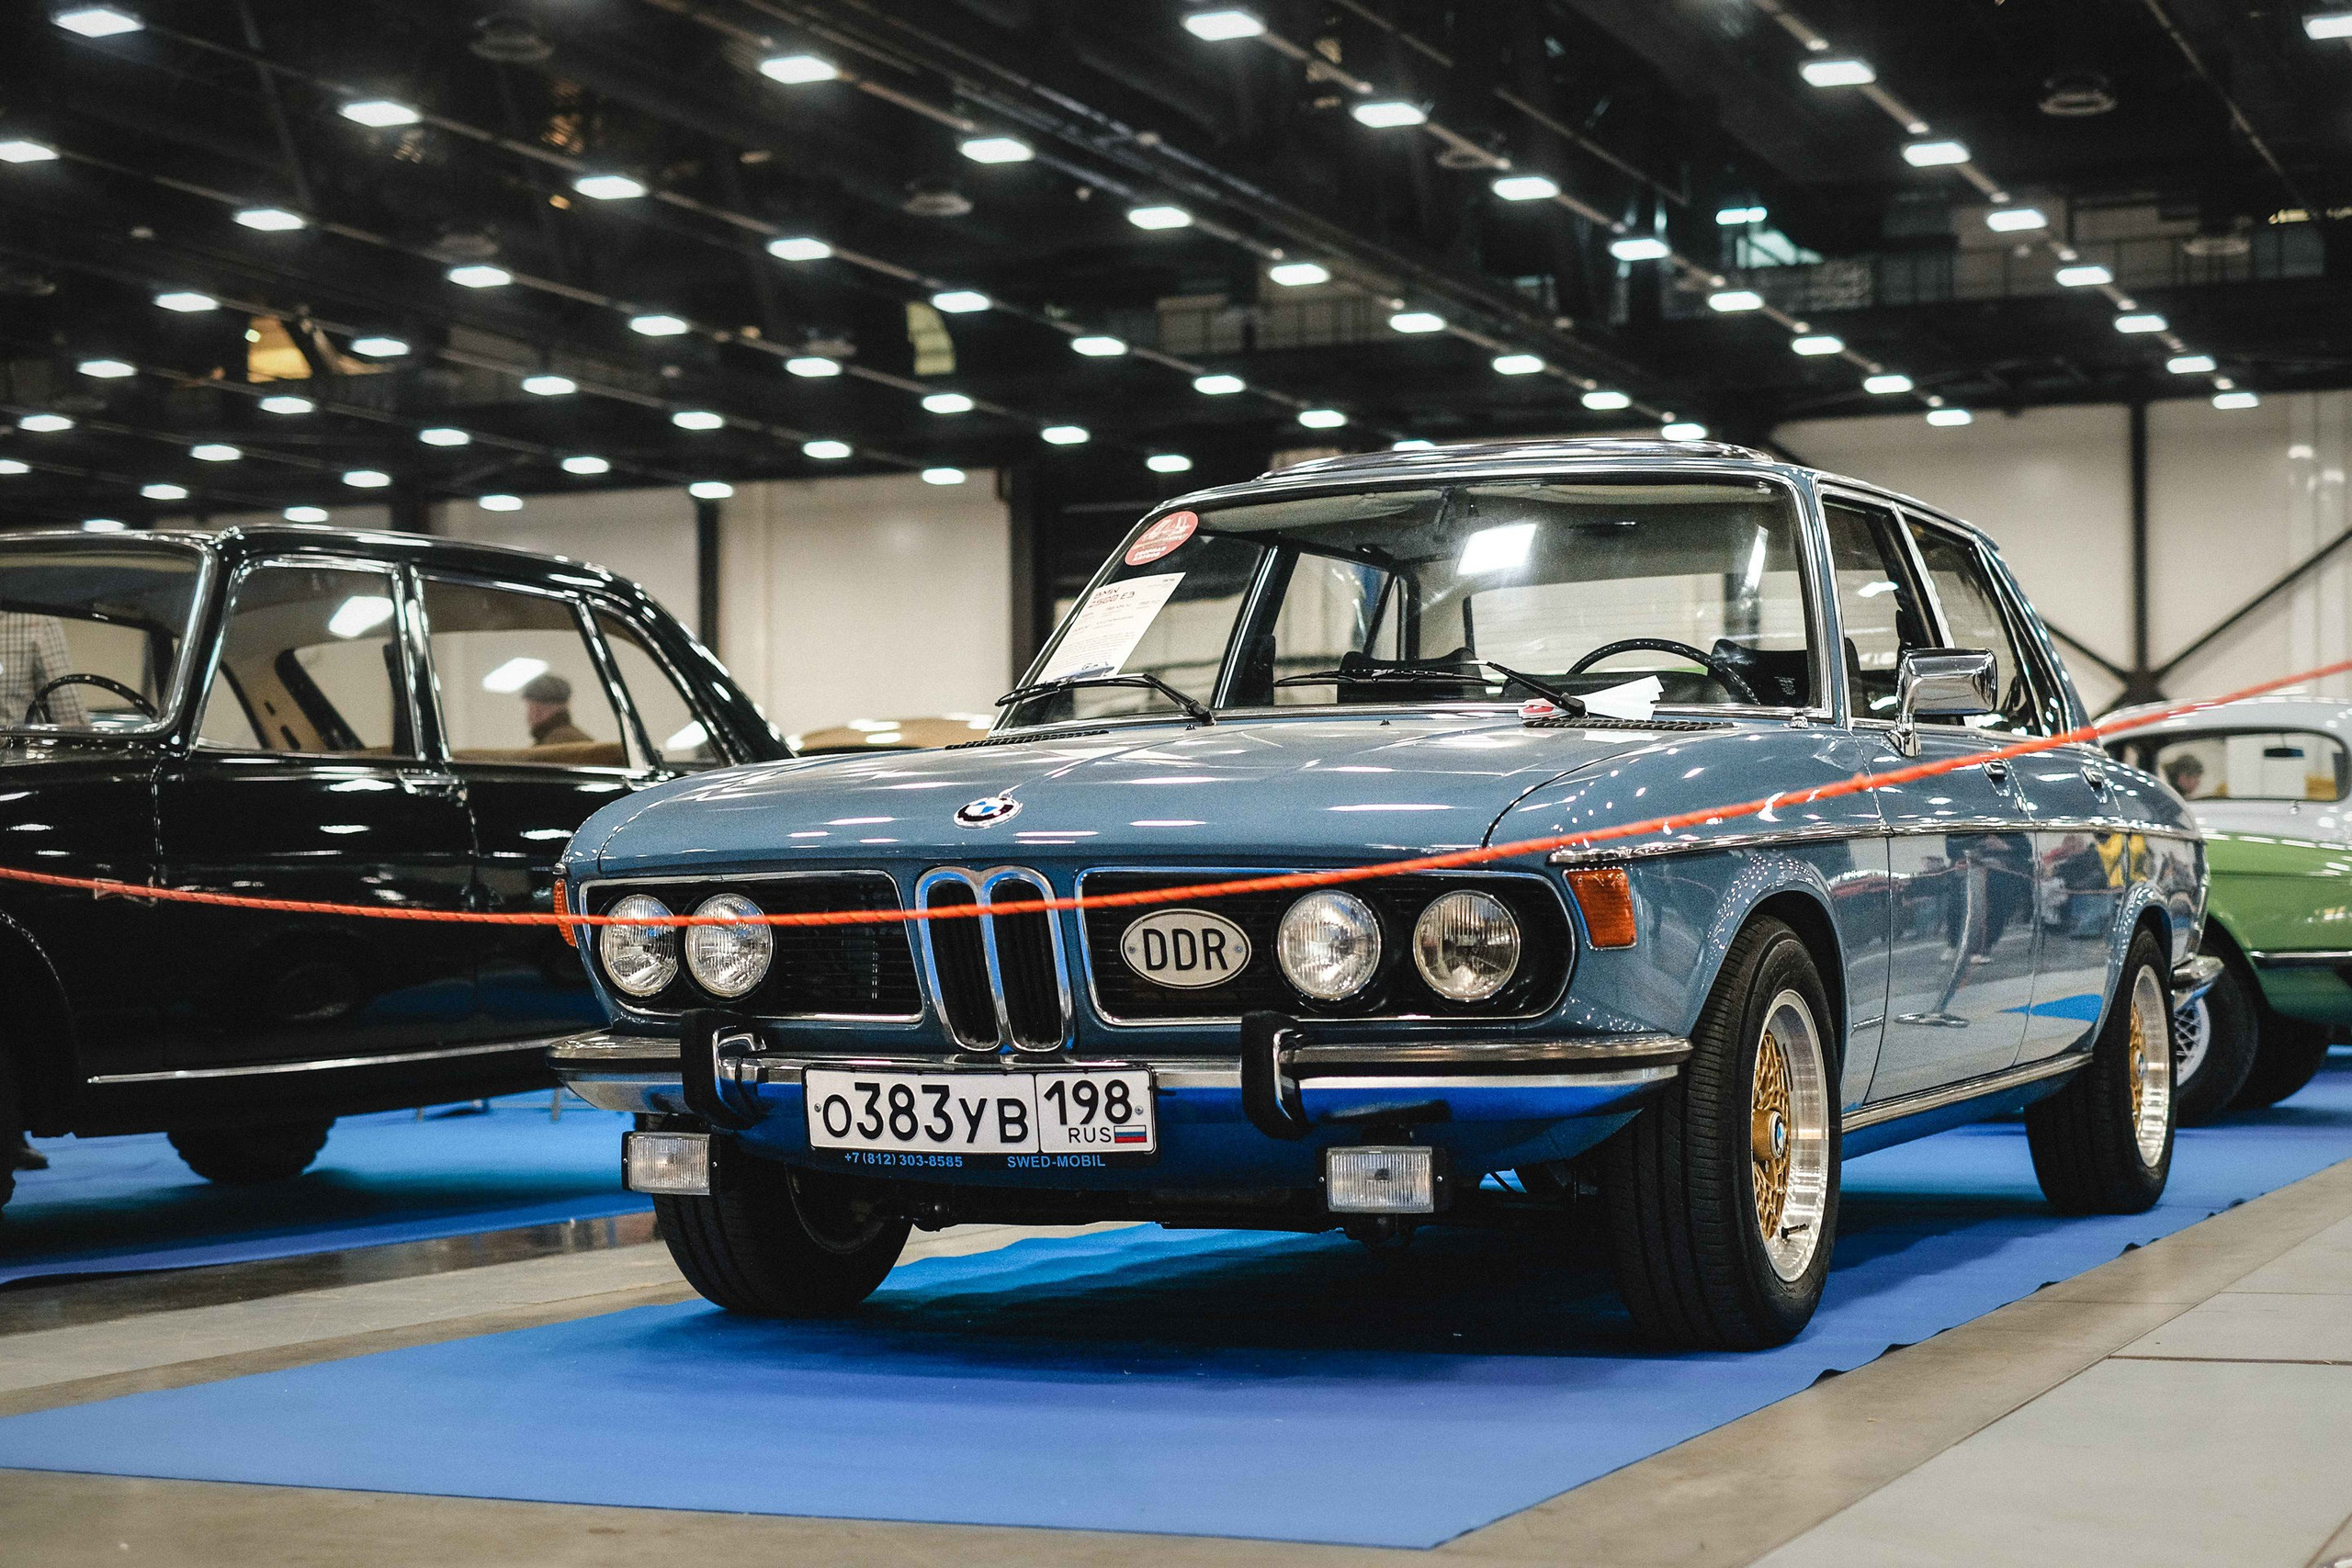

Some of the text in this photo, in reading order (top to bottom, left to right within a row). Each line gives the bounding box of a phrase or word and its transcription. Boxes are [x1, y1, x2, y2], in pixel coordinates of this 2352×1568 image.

[1142, 928, 1228, 971] DDR
[1043, 1079, 1133, 1125] 198
[1068, 1126, 1112, 1144] RUS
[844, 1152, 964, 1168] +7 (812) 303-8585
[1007, 1155, 1106, 1168] SWED-MOBIL
